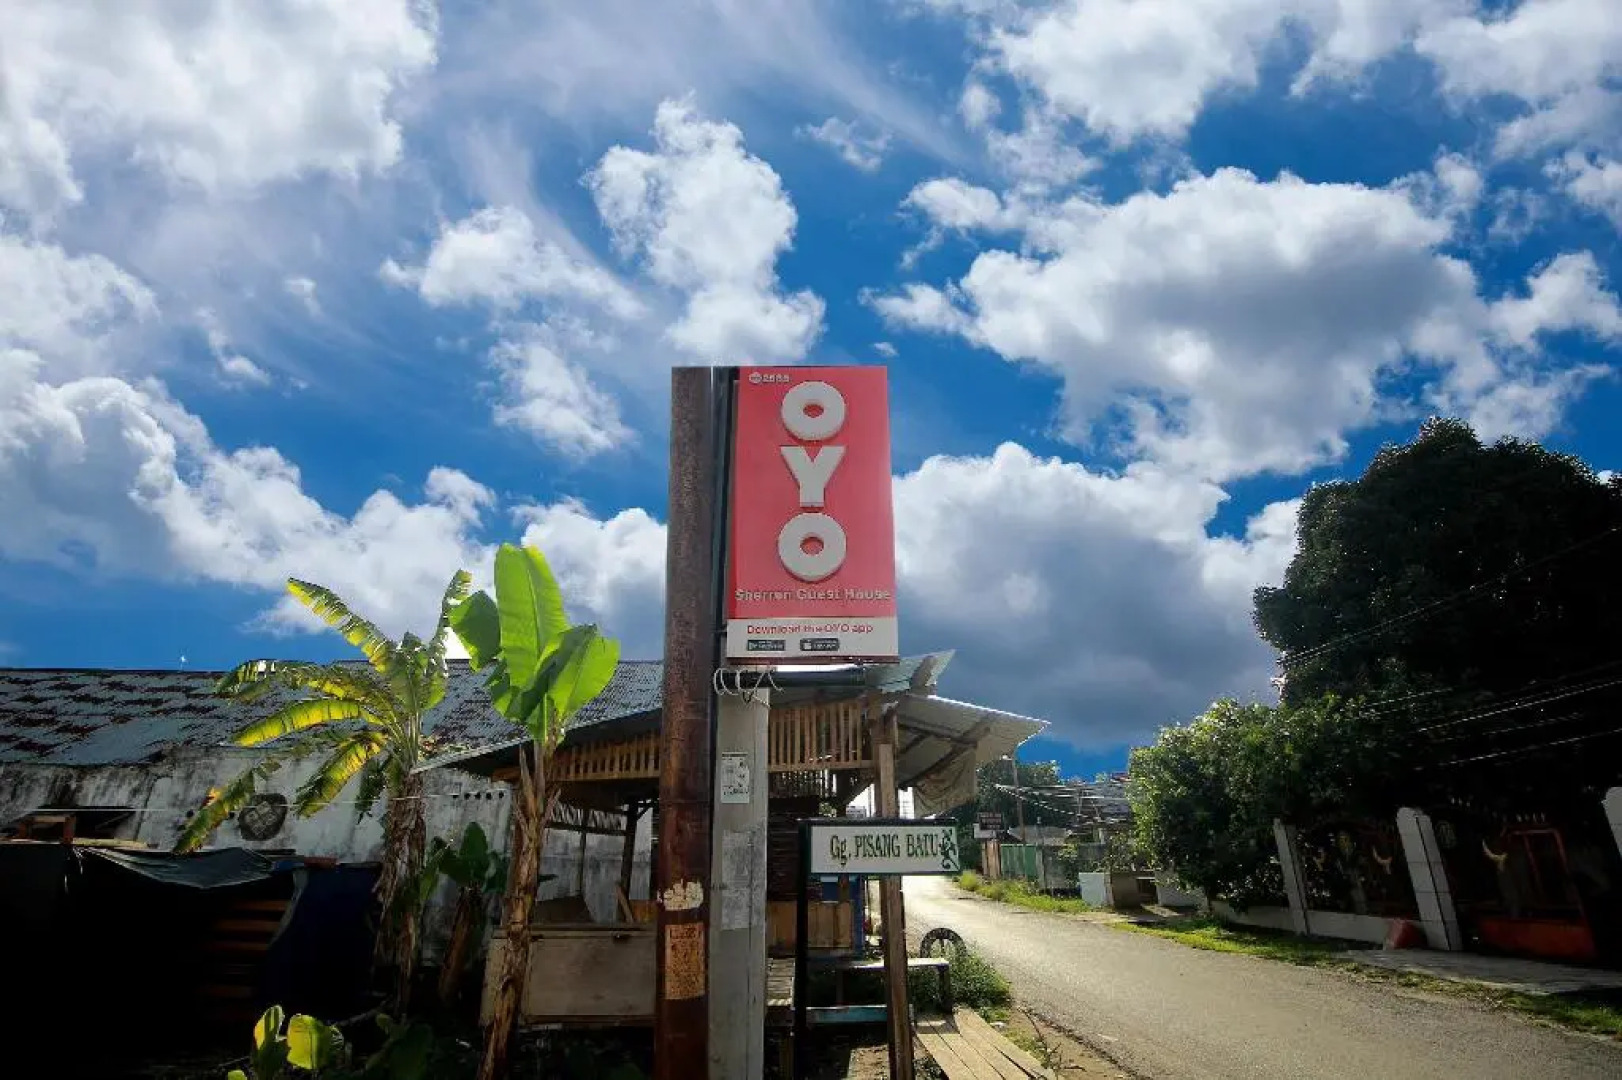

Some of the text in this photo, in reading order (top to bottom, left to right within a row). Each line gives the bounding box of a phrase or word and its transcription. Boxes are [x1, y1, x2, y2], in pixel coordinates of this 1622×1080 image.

[778, 380, 847, 582] OYO
[796, 588, 839, 600] Guest
[844, 588, 890, 600] House
[747, 623, 874, 635] Download the OYO app
[830, 833, 939, 866] Gg. PISANG BATU
